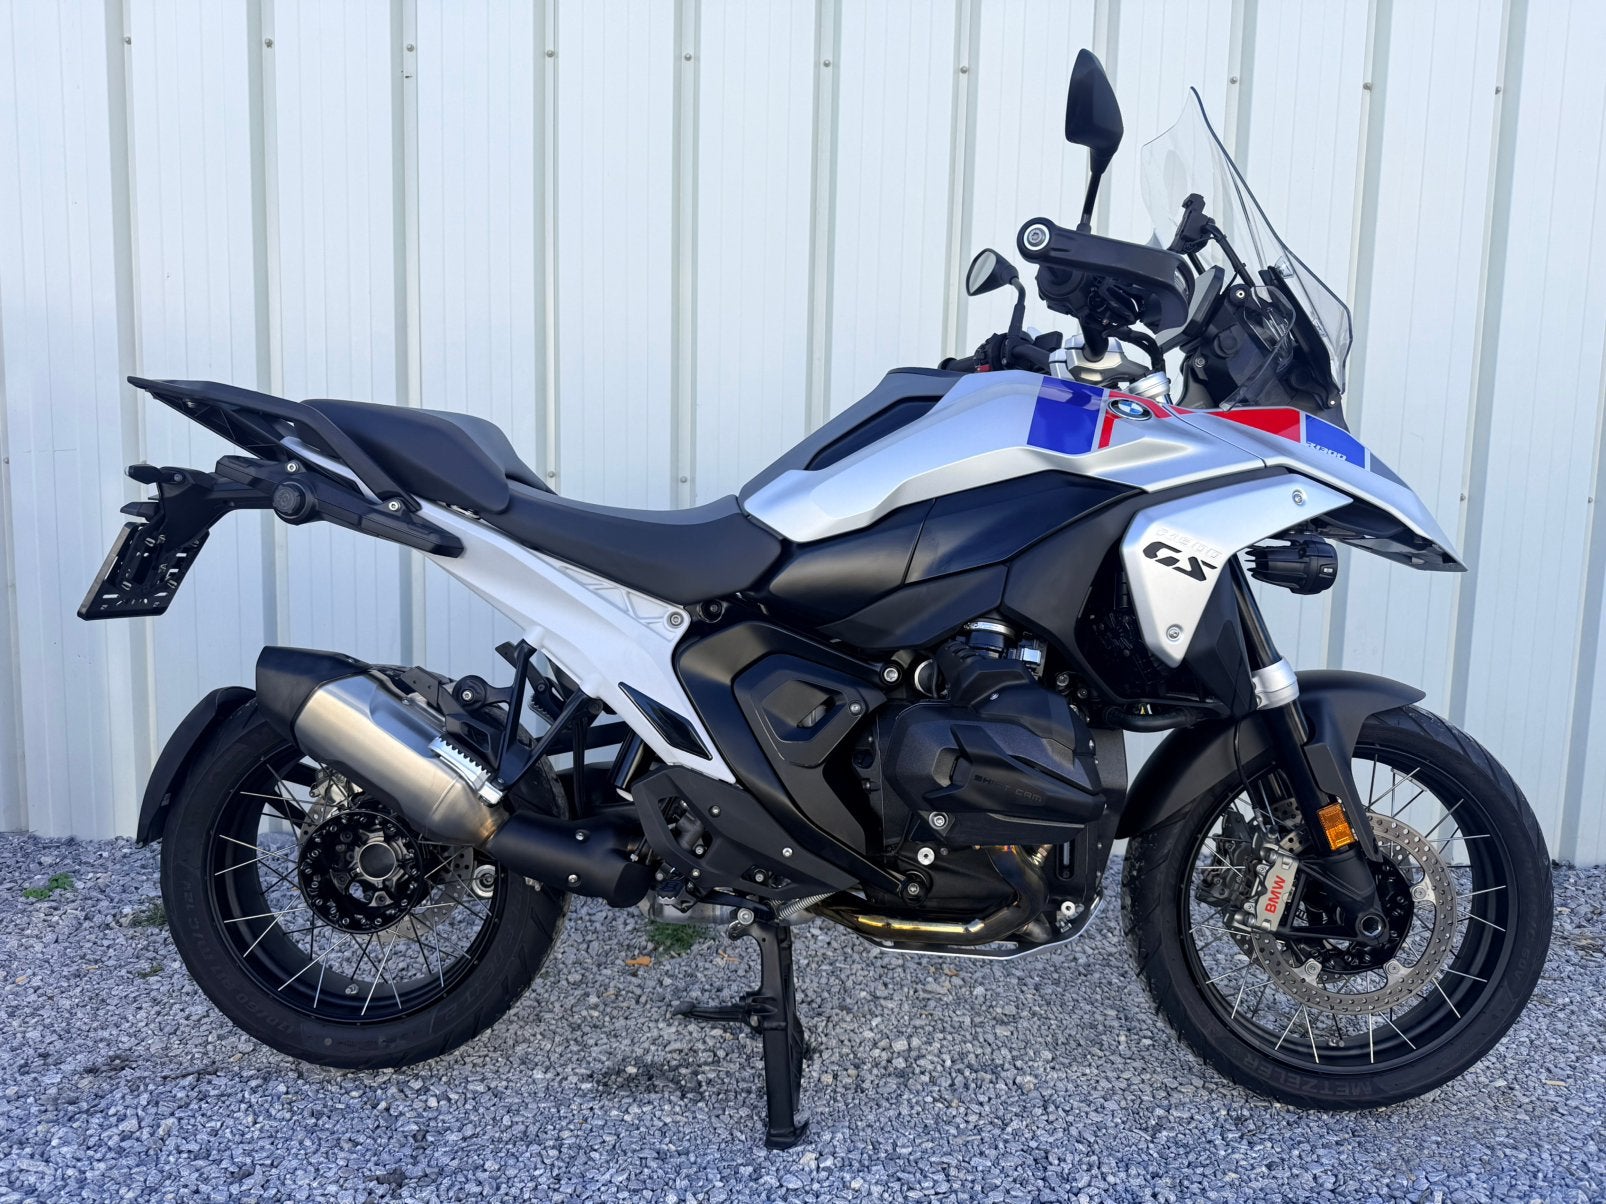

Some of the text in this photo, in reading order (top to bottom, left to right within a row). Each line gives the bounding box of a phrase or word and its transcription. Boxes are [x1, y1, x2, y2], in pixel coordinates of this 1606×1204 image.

[1142, 541, 1218, 582] GS
[1265, 875, 1286, 914] BMW
[1241, 1053, 1373, 1095] METZELER
